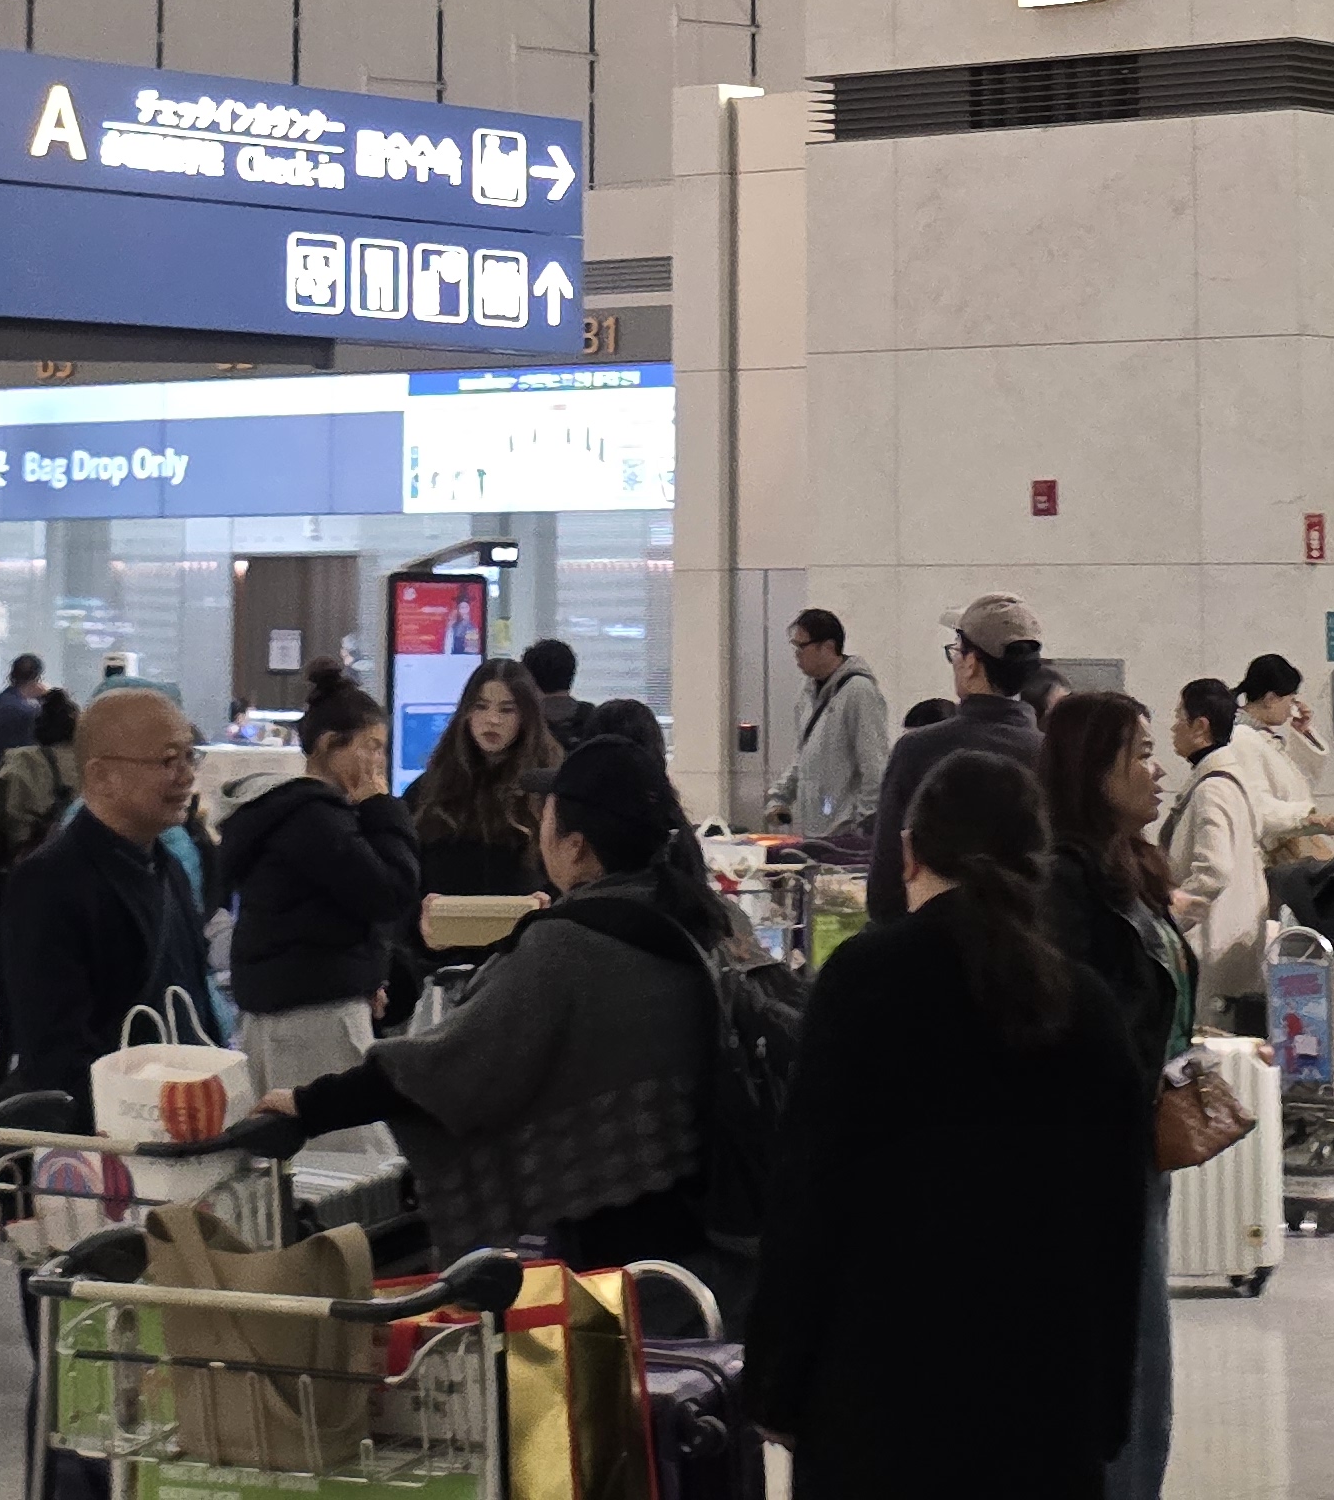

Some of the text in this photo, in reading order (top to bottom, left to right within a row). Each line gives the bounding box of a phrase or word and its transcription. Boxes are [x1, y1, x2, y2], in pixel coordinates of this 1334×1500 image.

[30, 84, 88, 161] A
[23, 447, 189, 489] Bag Drop Only
